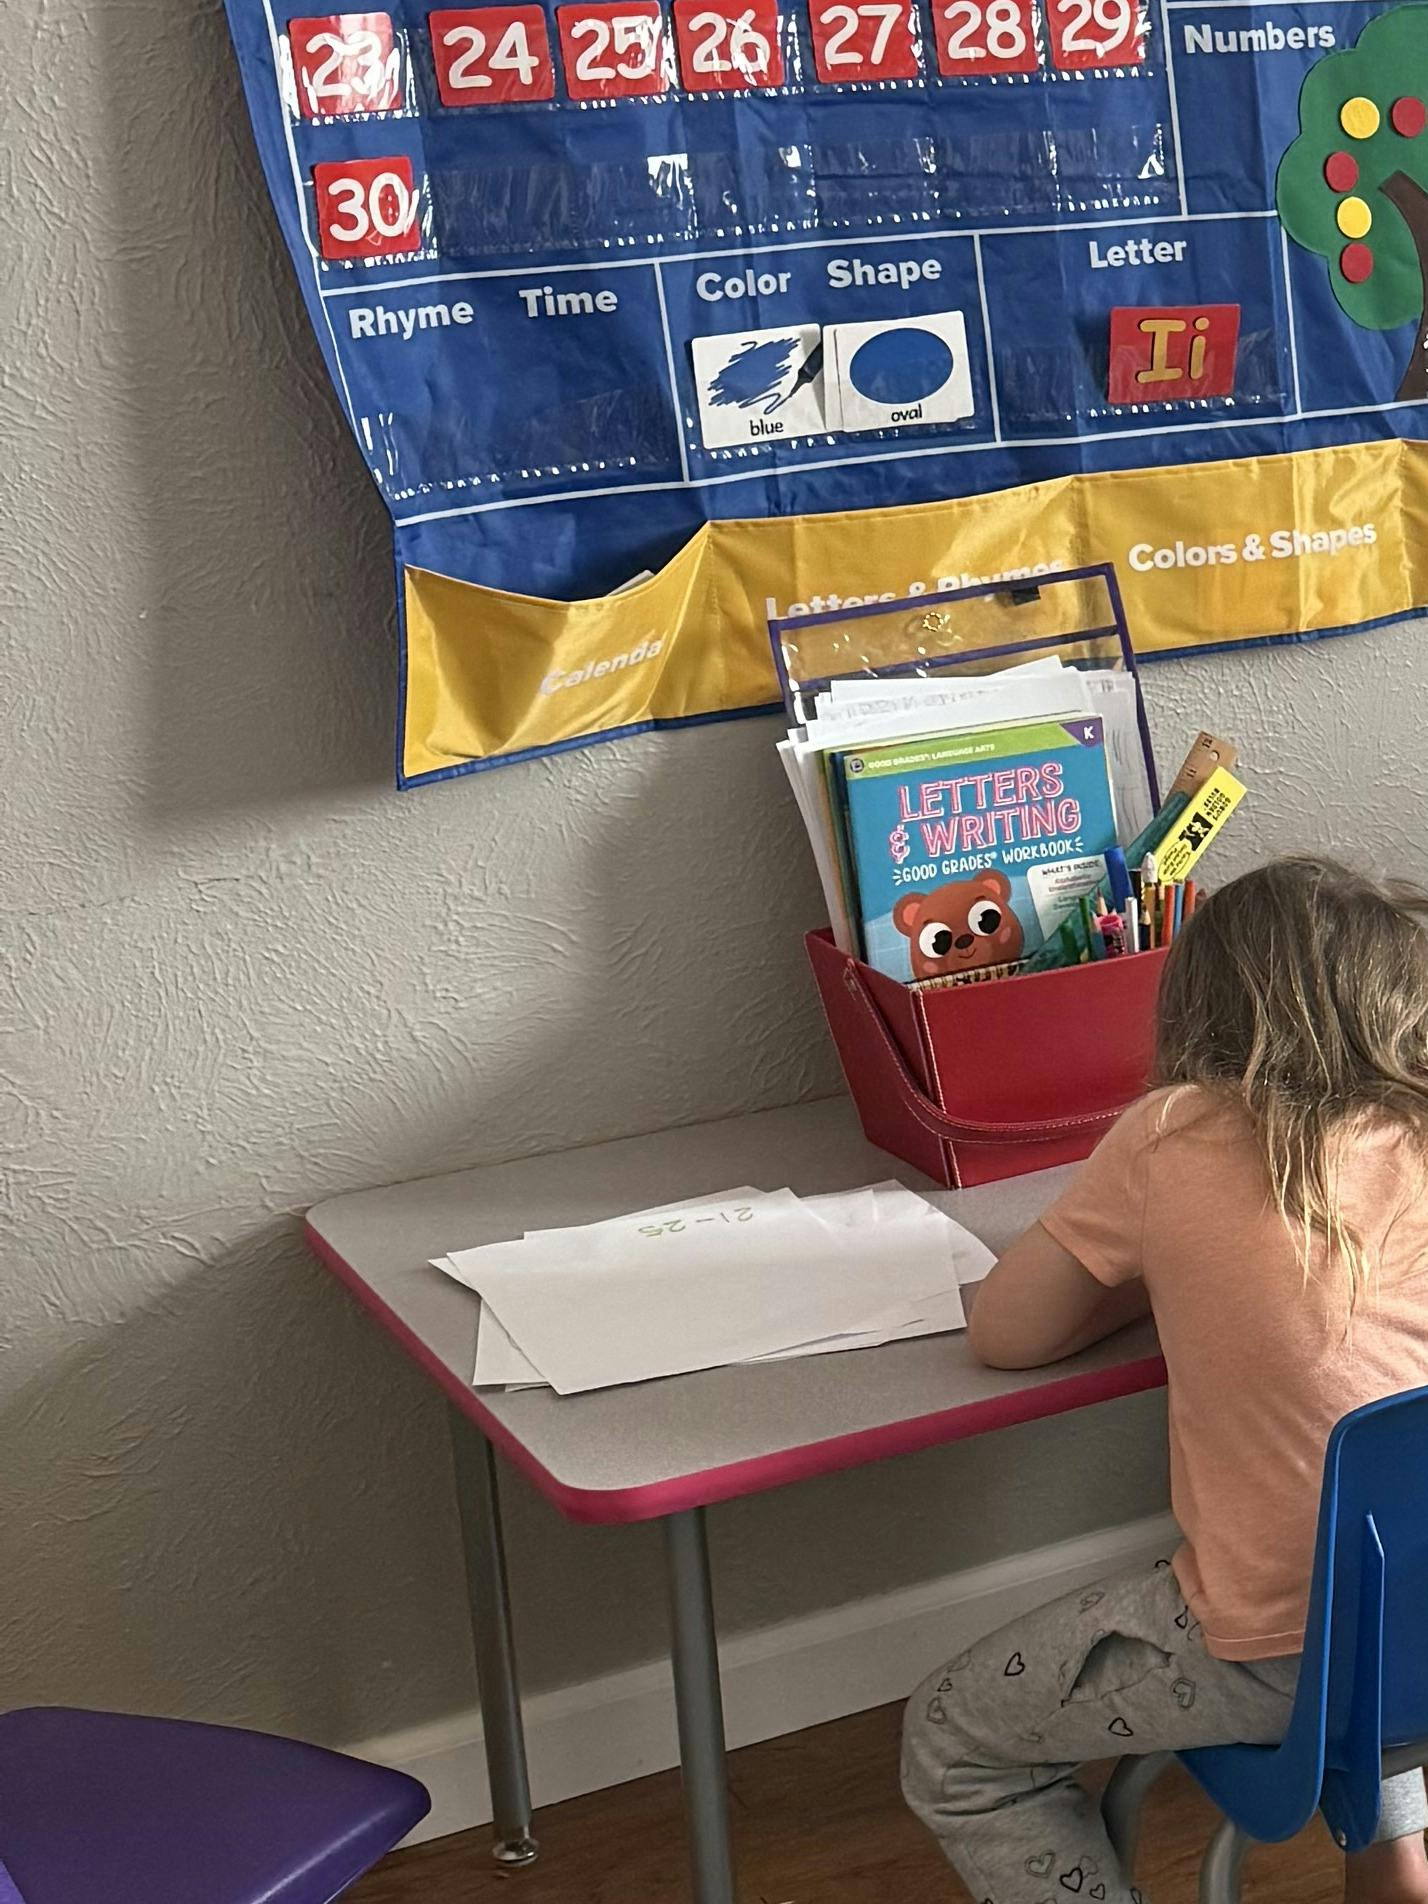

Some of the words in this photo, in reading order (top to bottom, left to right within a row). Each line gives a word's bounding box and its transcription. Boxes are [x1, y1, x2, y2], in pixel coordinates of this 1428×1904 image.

[305, 30, 384, 98] 23
[441, 20, 540, 90] 24
[570, 15, 658, 82] 25
[687, 8, 771, 77] 26
[819, 4, 904, 66] 27
[943, 0, 1027, 60] 28
[1184, 21, 1337, 55] Numbers
[327, 171, 412, 242] 30
[695, 268, 791, 303] Color
[826, 257, 943, 291] Shape
[1089, 238, 1188, 270] Letter
[348, 301, 475, 341] Rhyme
[518, 285, 618, 318] Time
[1136, 317, 1211, 385] Ii
[749, 417, 785, 438] blue
[890, 403, 923, 423] oval
[1128, 541, 1236, 573] Colors
[1241, 532, 1267, 563] &
[1269, 521, 1378, 559] Shapes
[539, 637, 665, 696] Calenda
[1083, 726, 1094, 739] K
[899, 762, 1064, 823] LETTERS
[889, 822, 911, 864] &
[920, 798, 1083, 859] WRITING
[902, 864, 938, 883] GOOD
[1002, 838, 1073, 864] WORKBOOK
